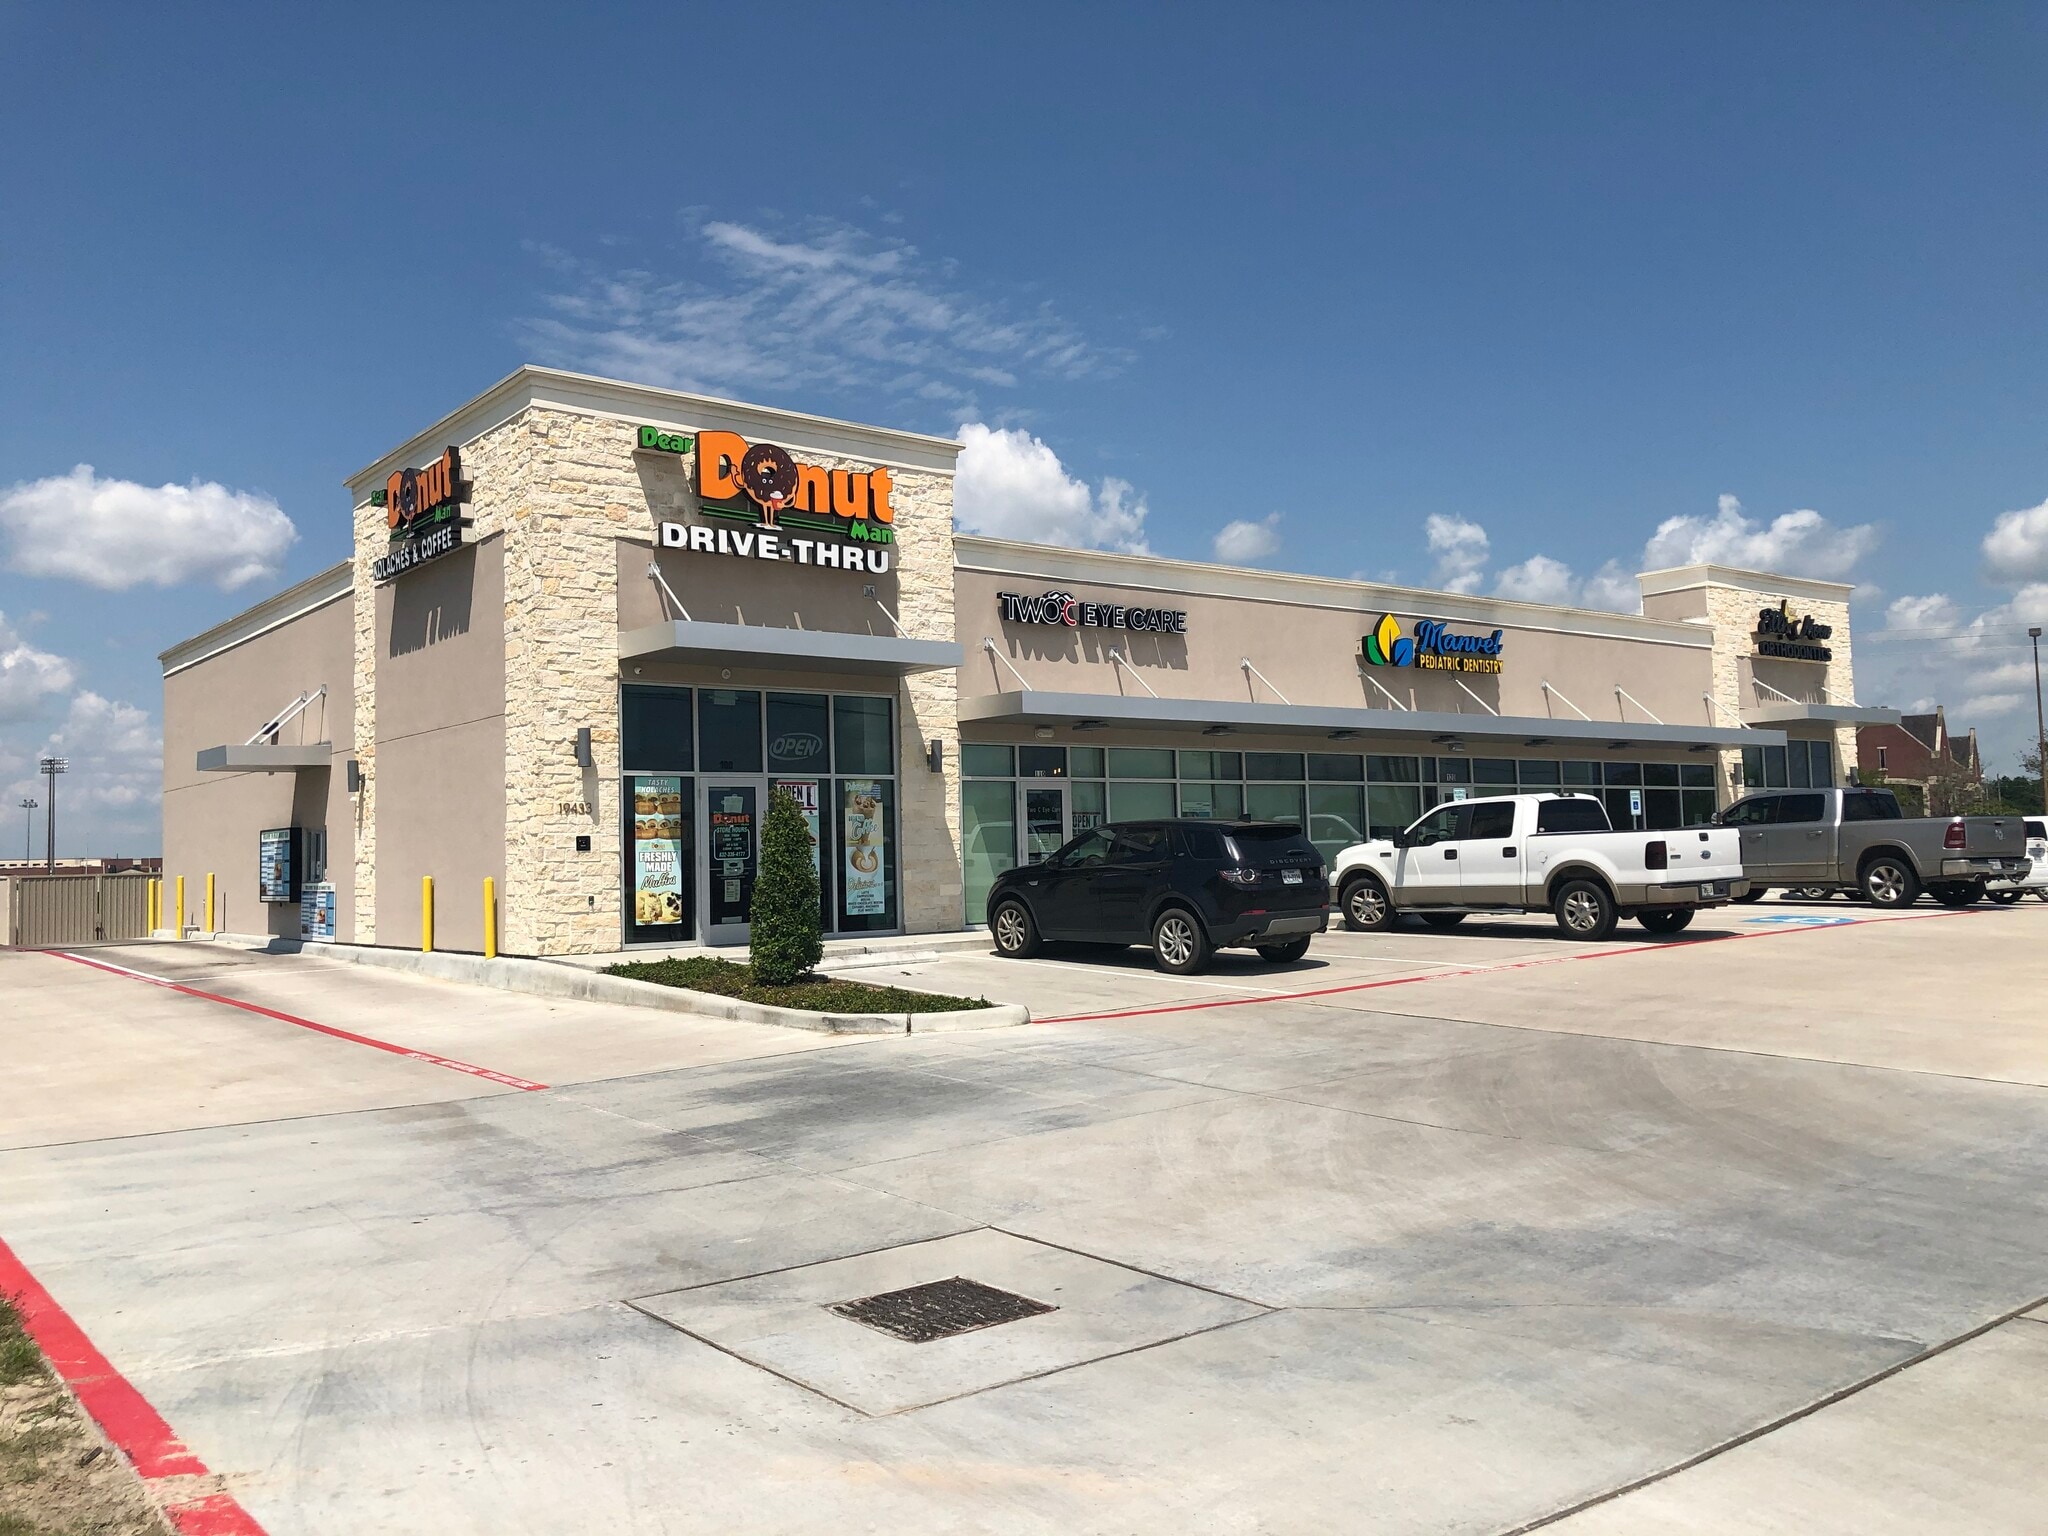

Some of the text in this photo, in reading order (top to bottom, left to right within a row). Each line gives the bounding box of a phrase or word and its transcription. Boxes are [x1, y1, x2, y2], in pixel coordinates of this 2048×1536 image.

[638, 425, 693, 454] Dear
[696, 430, 894, 524] Donut
[386, 447, 452, 530] Donut
[434, 503, 451, 523] Man
[849, 519, 894, 544] Man
[373, 525, 453, 581] KOLACHES & COFFEE
[659, 521, 890, 574] DRIVE-THRU
[1082, 601, 1126, 629] EYE
[1128, 606, 1188, 634] CARE
[1416, 619, 1503, 655] Manvel
[1759, 641, 1833, 662] ORTHODONTICS
[1419, 654, 1504, 675] PEDIATRIC DENTISTRY
[772, 737, 819, 758] OPEN
[641, 786, 676, 794] KOLACHES
[1072, 814, 1091, 828] OPEN
[639, 851, 677, 862] FRESHLY
[645, 861, 673, 873] MADE
[640, 872, 677, 891] Muffins
